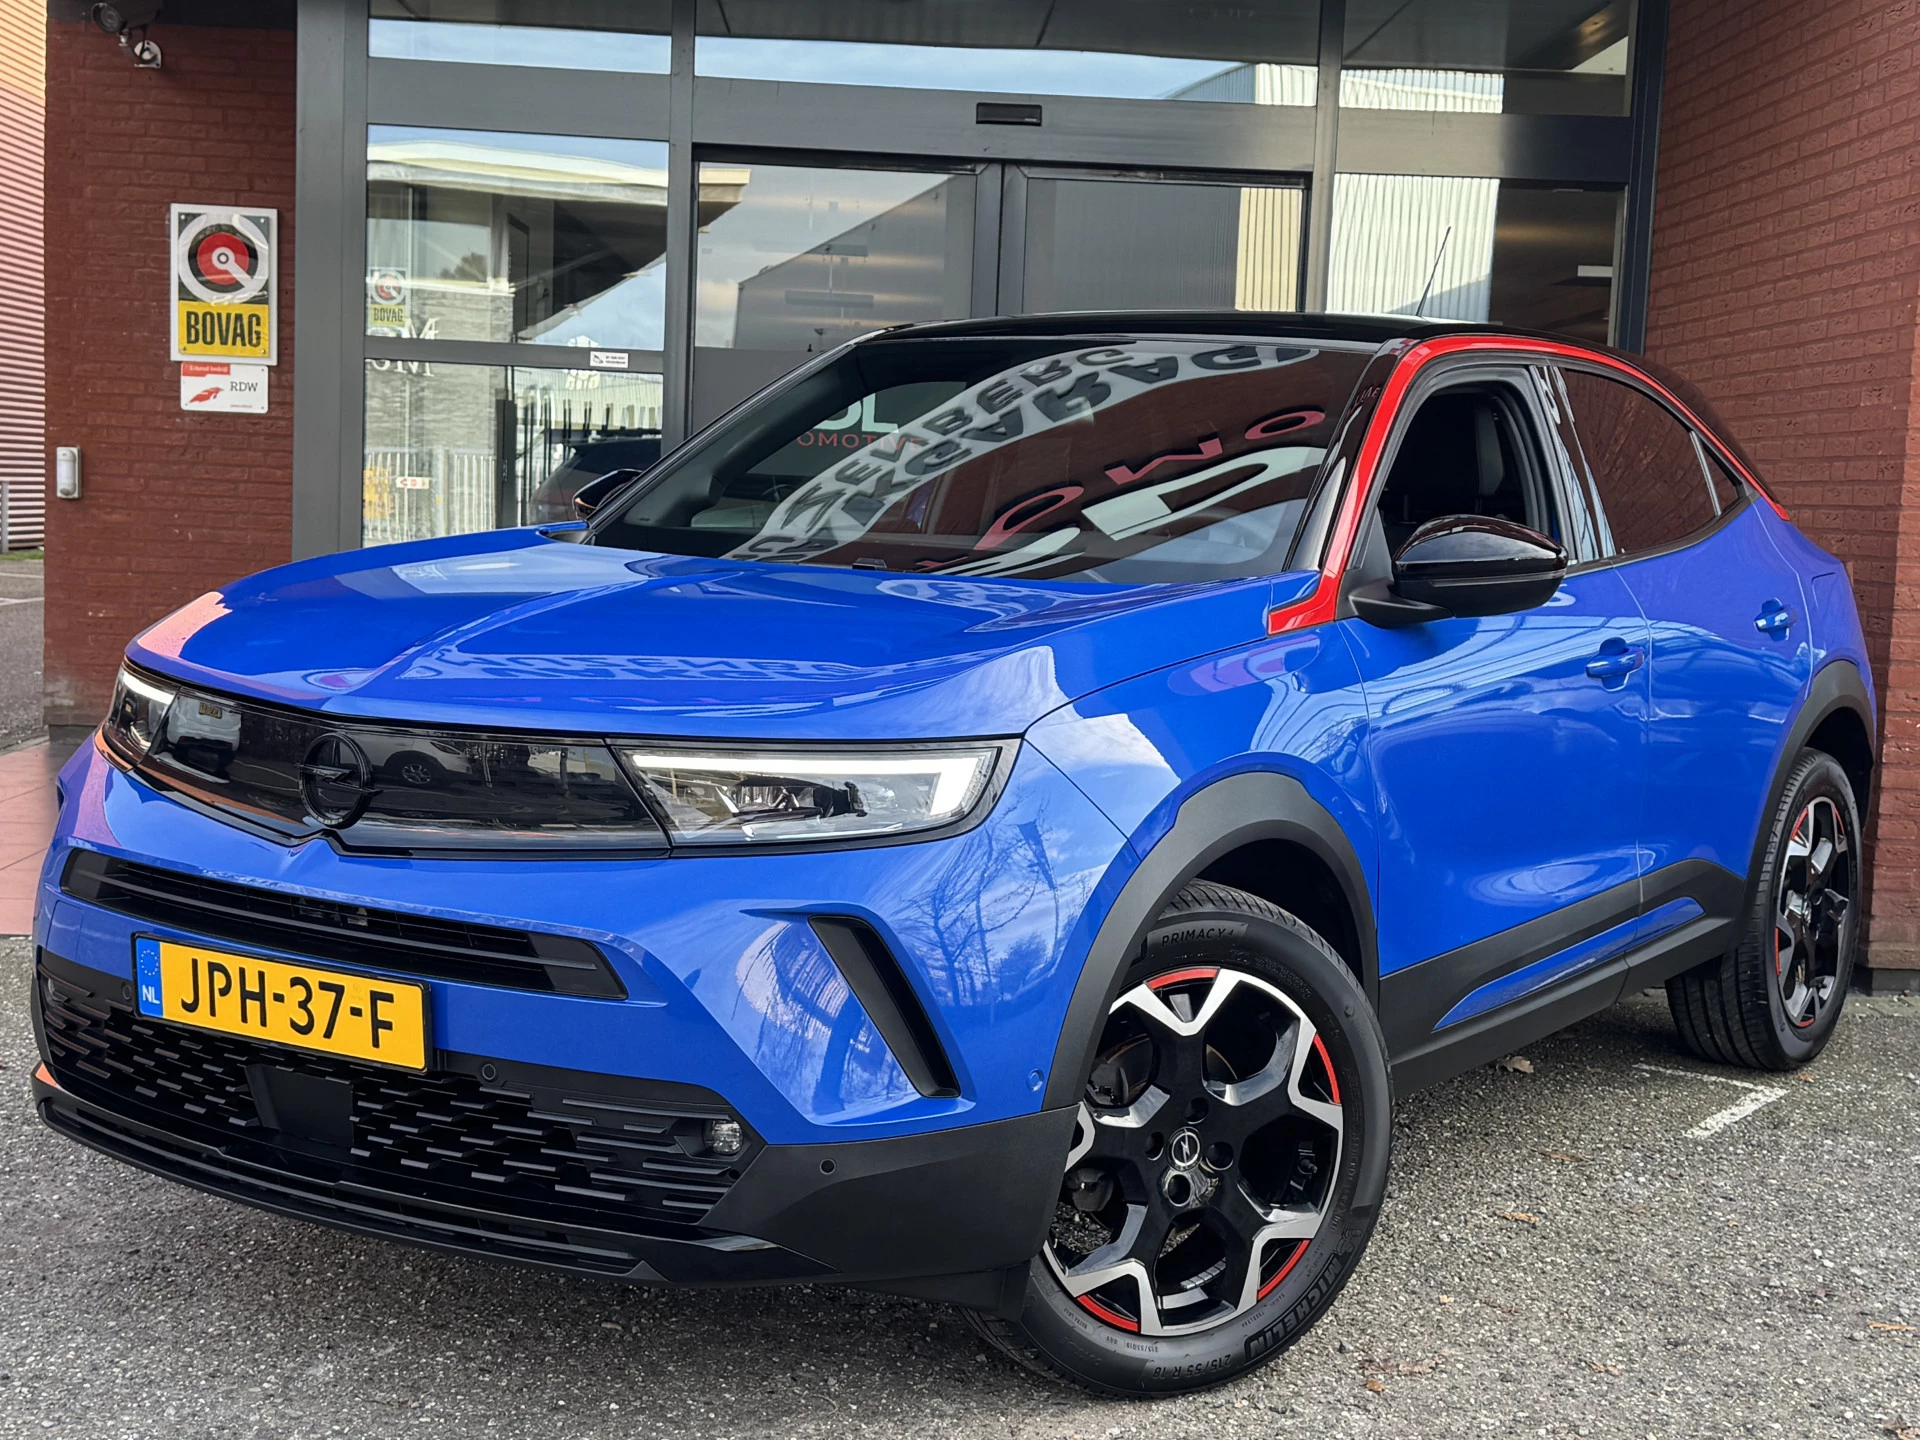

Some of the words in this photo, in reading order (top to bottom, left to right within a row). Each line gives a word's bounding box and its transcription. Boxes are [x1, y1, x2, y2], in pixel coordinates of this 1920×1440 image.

[373, 307, 403, 323] BOVAG
[185, 310, 262, 348] BOVAG
[230, 380, 258, 392] RDW
[1161, 927, 1226, 947] PRIMACY
[142, 985, 161, 1005] NL
[180, 957, 395, 1049] JPH-37-F
[1248, 1257, 1340, 1360] MICHELIN
[1152, 1366, 1167, 1379] 18
[1186, 1353, 1232, 1377] 215/55
